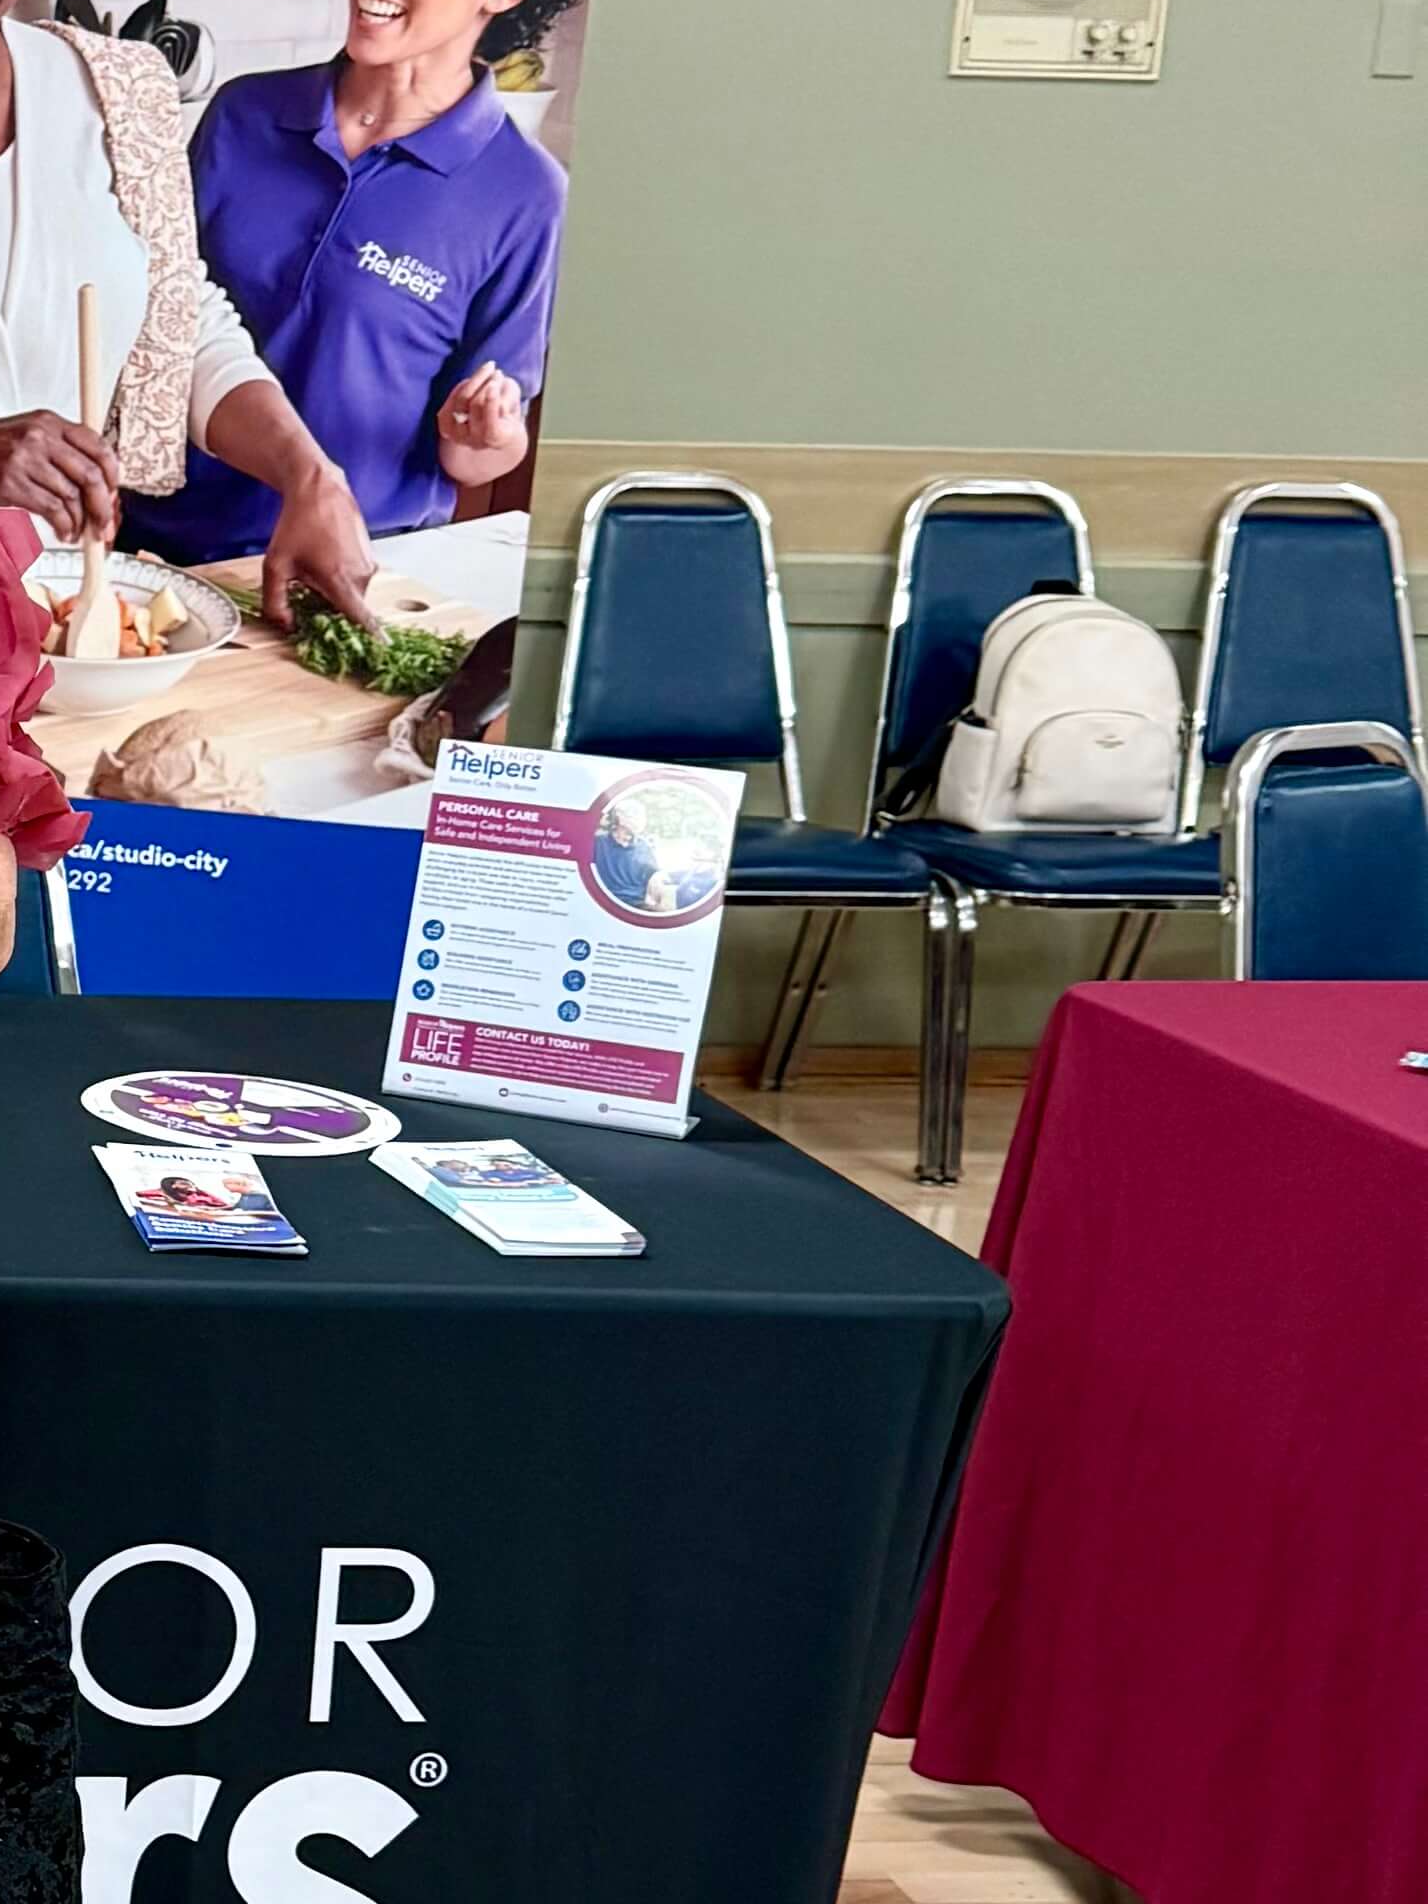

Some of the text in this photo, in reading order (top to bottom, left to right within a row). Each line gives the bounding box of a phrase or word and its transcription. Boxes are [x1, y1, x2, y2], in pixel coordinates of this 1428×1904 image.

[358, 250, 443, 302] Helpers
[450, 752, 543, 780] Helpers
[438, 800, 541, 823] PERSONAL CARE
[434, 826, 457, 838] Safe
[457, 831, 477, 841] and
[541, 839, 572, 855] Living
[479, 819, 504, 831] Care
[546, 827, 563, 838] for
[68, 839, 229, 879] ca/studio-city
[68, 869, 113, 894] 292
[413, 1027, 465, 1056] LIFE
[475, 1027, 591, 1053] CONTACT US TODAY!
[411, 1049, 462, 1066] PROFILE
